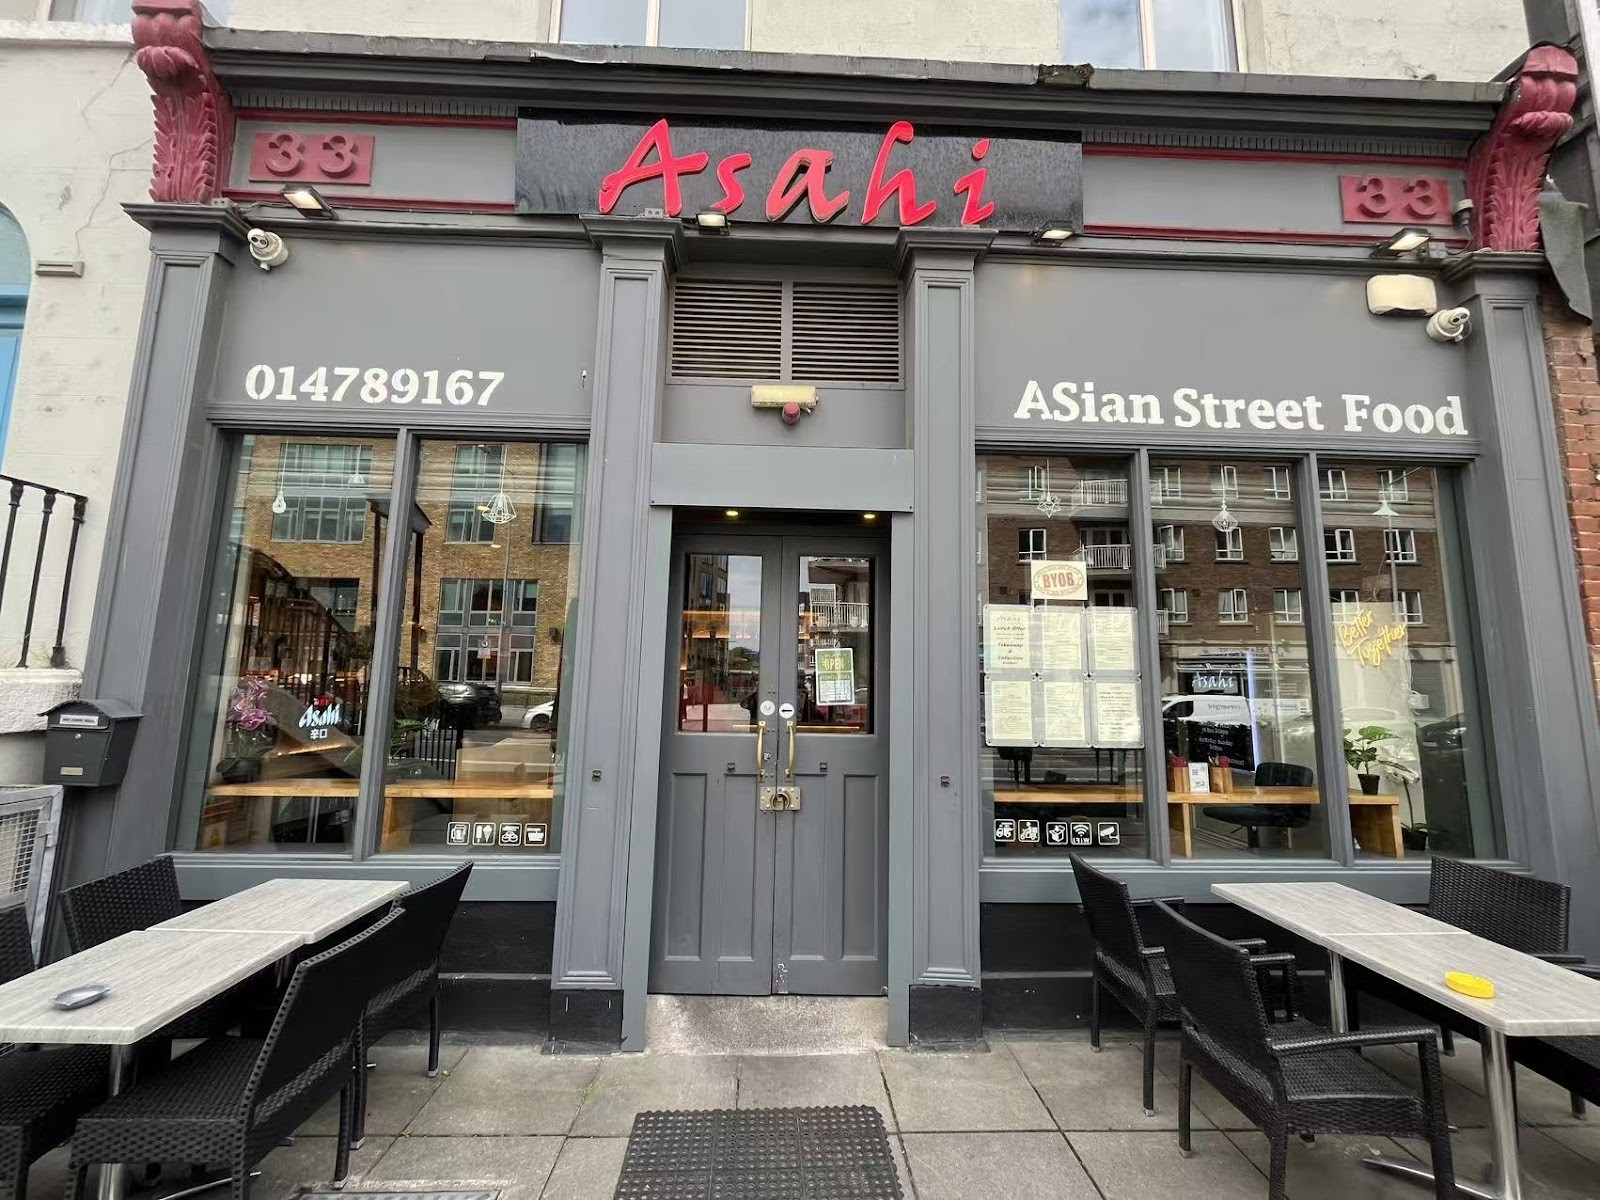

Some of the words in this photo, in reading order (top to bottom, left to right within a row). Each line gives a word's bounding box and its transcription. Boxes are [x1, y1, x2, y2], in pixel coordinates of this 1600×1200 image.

[264, 131, 358, 178] 33
[599, 118, 997, 226] Asahi
[1357, 175, 1438, 219] 33
[245, 364, 506, 407] 014789167
[1013, 379, 1165, 426] ASian
[1172, 387, 1325, 431] Street
[1342, 393, 1469, 437] Food
[1042, 571, 1075, 589] BYOB
[1338, 608, 1373, 648] Better
[1348, 624, 1407, 667] Together
[1191, 669, 1235, 688] Asahi
[298, 703, 341, 728] Asahi
